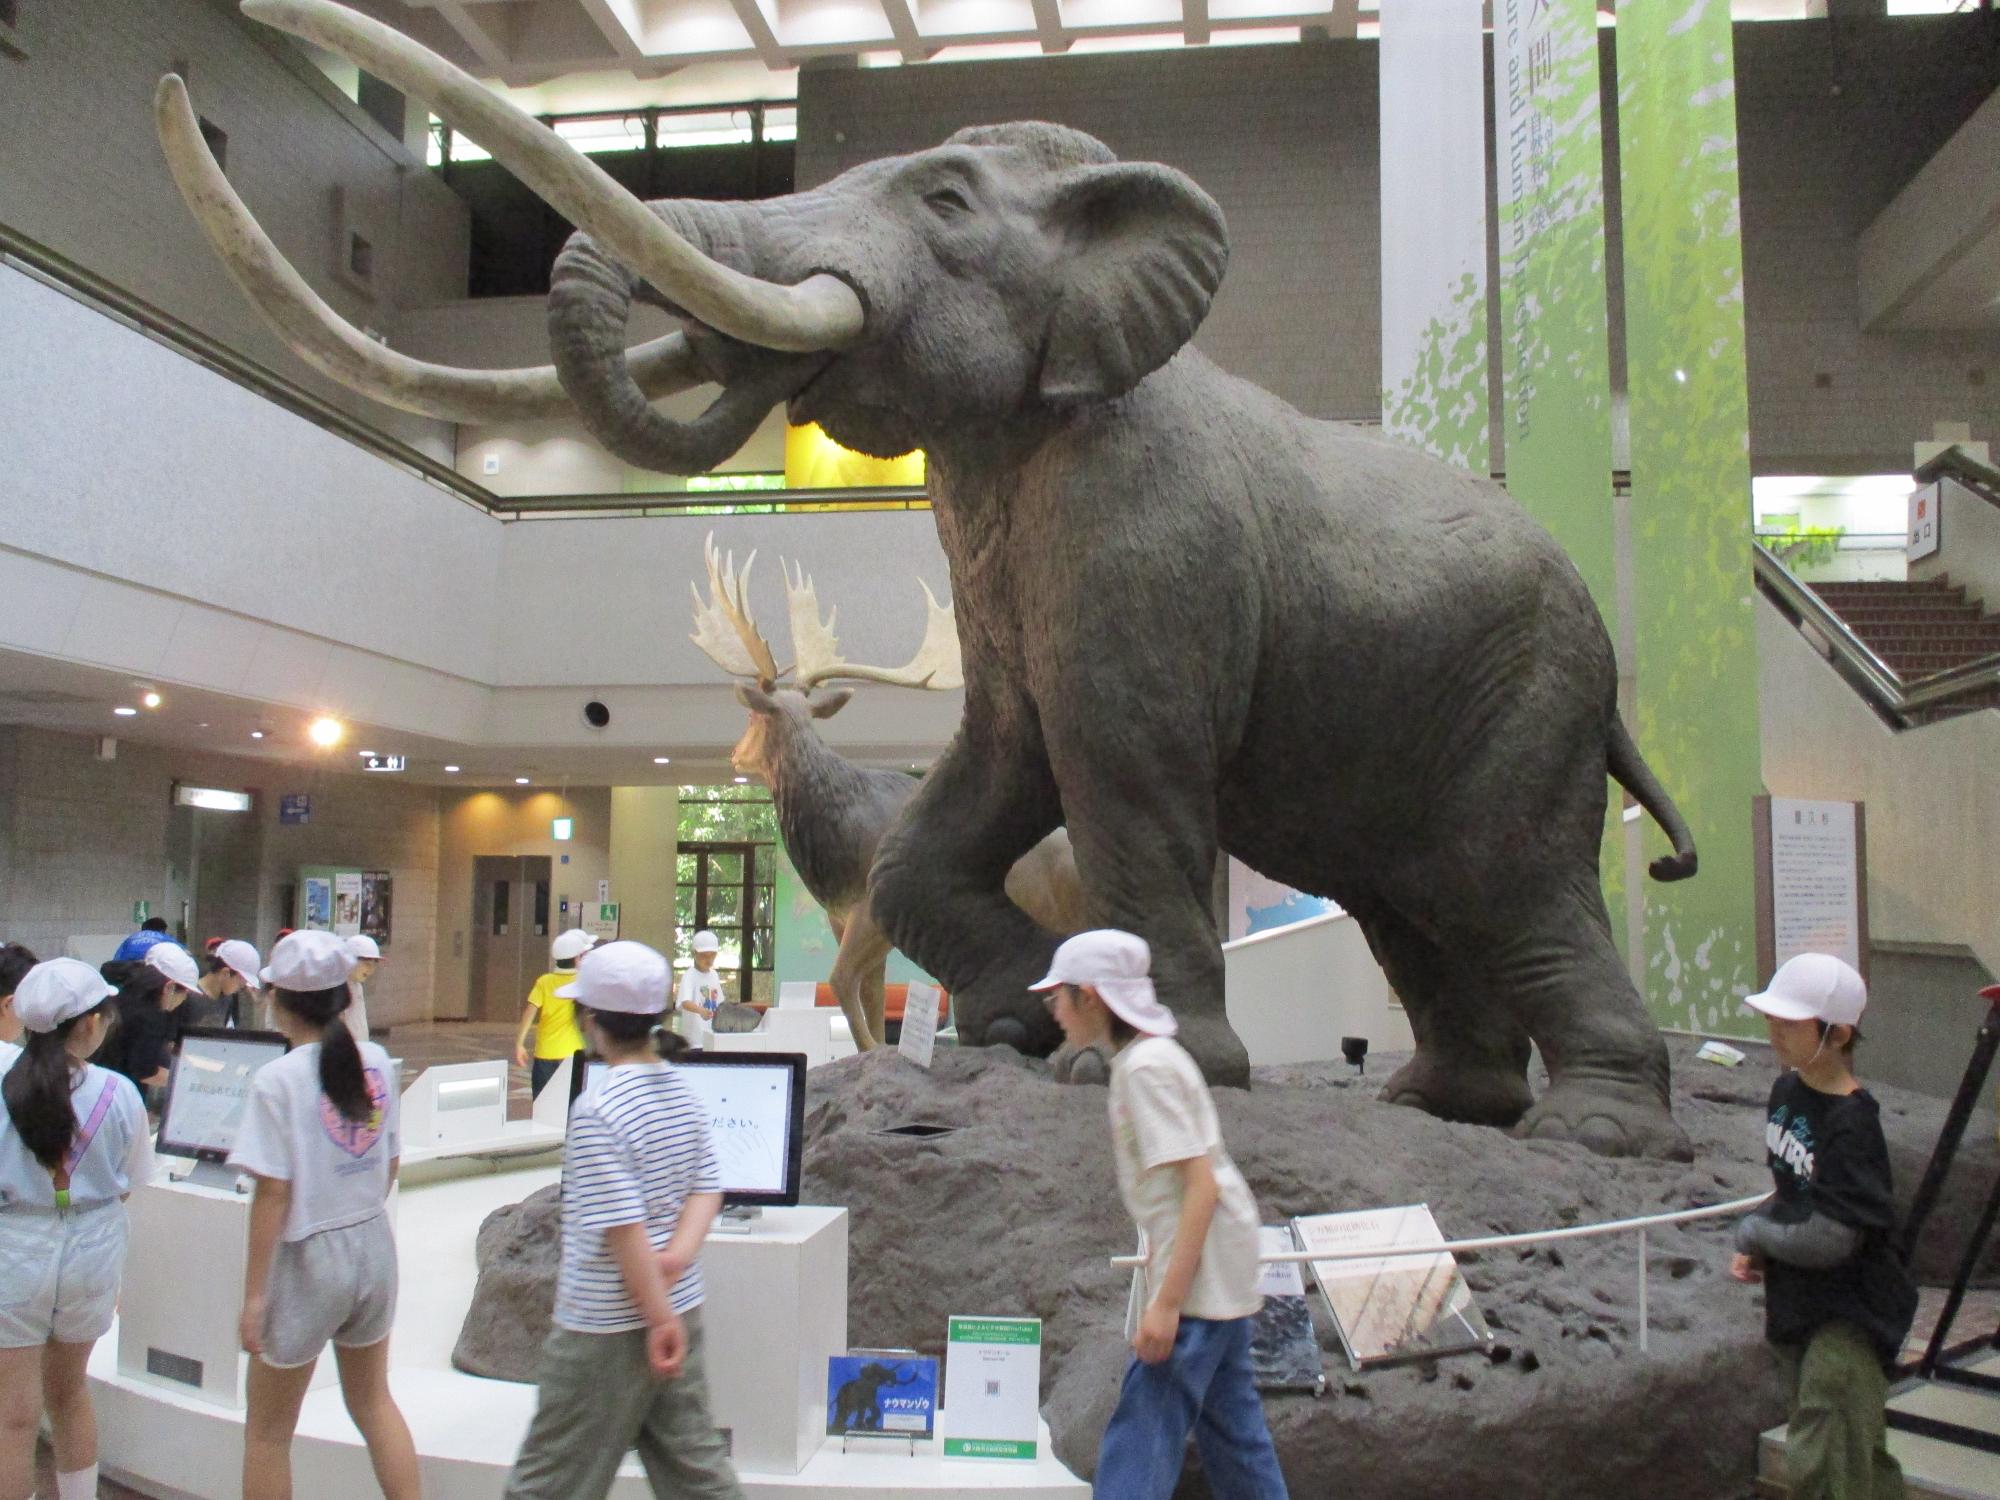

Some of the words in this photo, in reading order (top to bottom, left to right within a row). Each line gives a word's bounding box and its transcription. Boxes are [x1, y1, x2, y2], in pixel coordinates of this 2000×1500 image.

[1508, 55, 1526, 119] and
[1510, 120, 1527, 246] Human
[1514, 251, 1532, 441] Interaction
[883, 1397, 930, 1409] ナウマンゾウ
